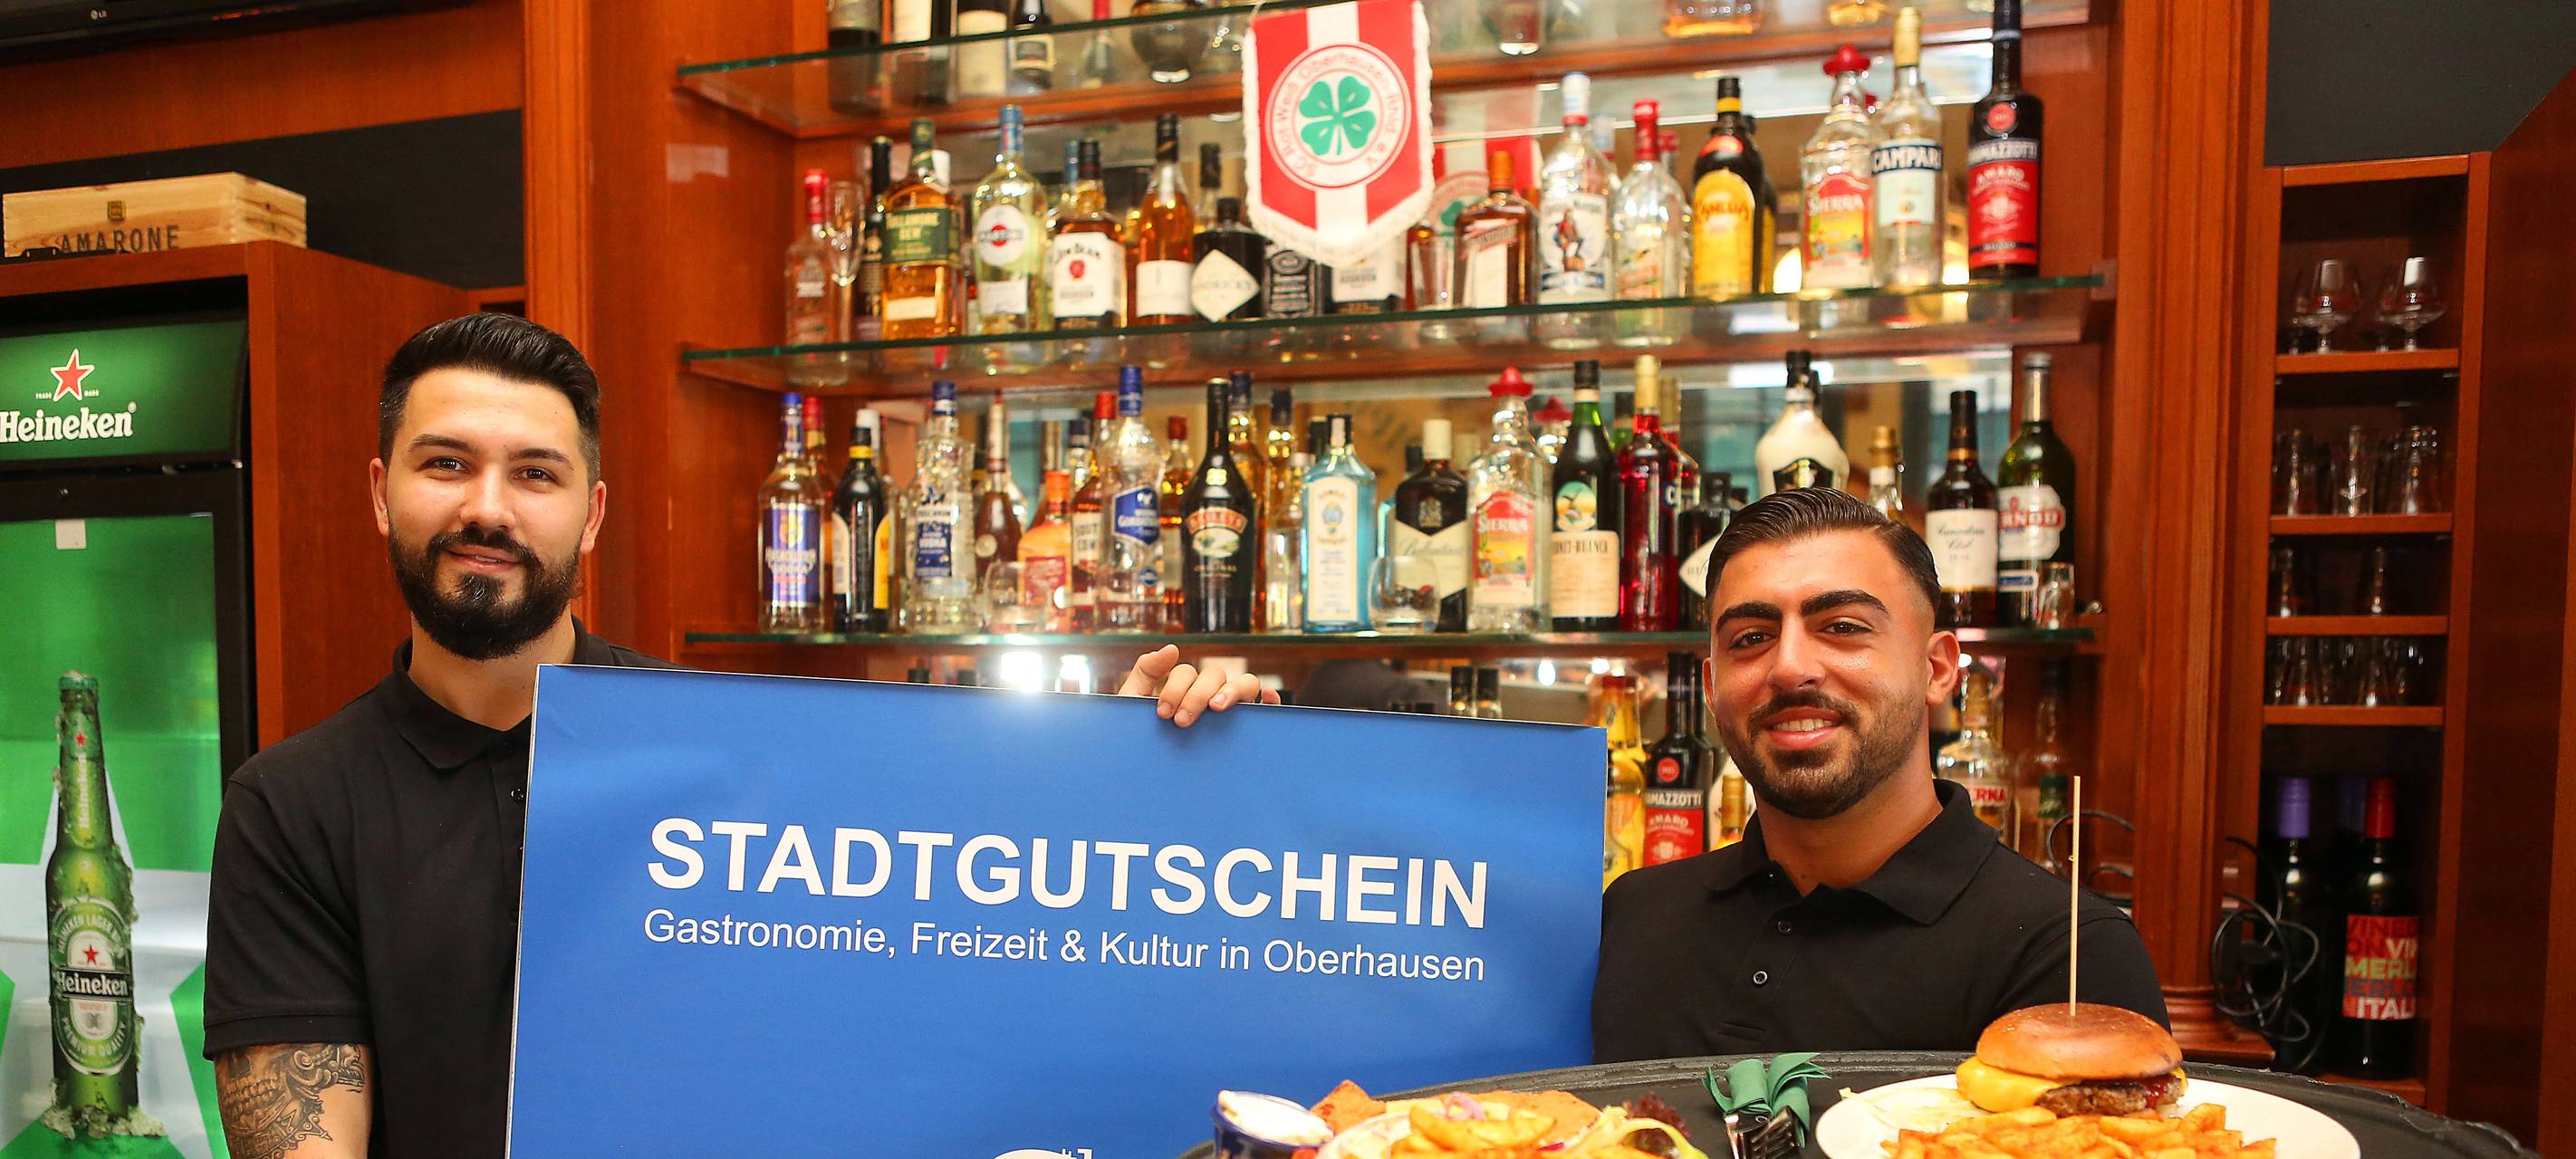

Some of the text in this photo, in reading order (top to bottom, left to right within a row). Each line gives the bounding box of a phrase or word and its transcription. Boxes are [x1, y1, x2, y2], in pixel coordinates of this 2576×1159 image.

[61, 225, 181, 253] AMARONE
[0, 407, 133, 443] Heineken
[1647, 791, 1702, 806] MAZZOTTI
[1649, 814, 1689, 828] AMARO
[648, 819, 1487, 929] STADTGUTSCHEIN
[645, 909, 1484, 981] Gastronomie, Freizeit & Kultur in Oberhausen
[58, 971, 129, 996] Heineken
